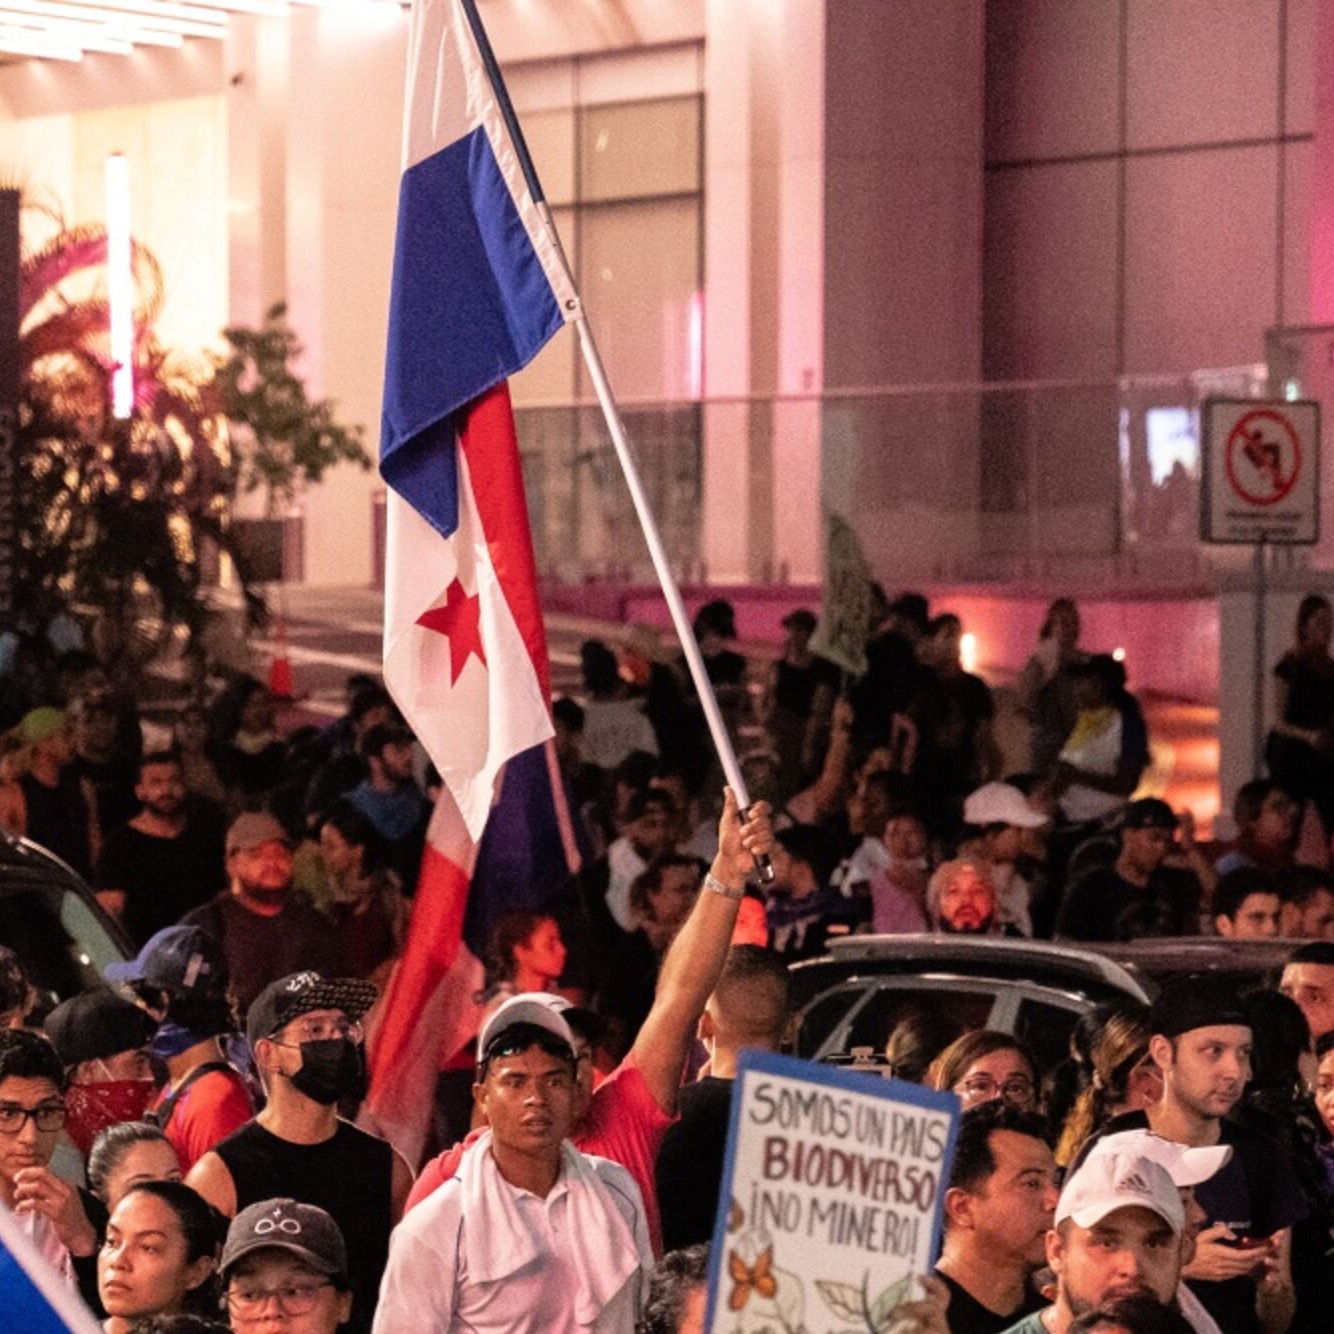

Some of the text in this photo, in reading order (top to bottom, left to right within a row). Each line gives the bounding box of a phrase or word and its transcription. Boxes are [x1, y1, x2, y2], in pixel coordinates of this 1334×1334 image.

[749, 1083, 947, 1163] SOMOS UN PAIS
[761, 1135, 937, 1213] BIODIVERSO
[805, 1197, 921, 1266] MINERO!
